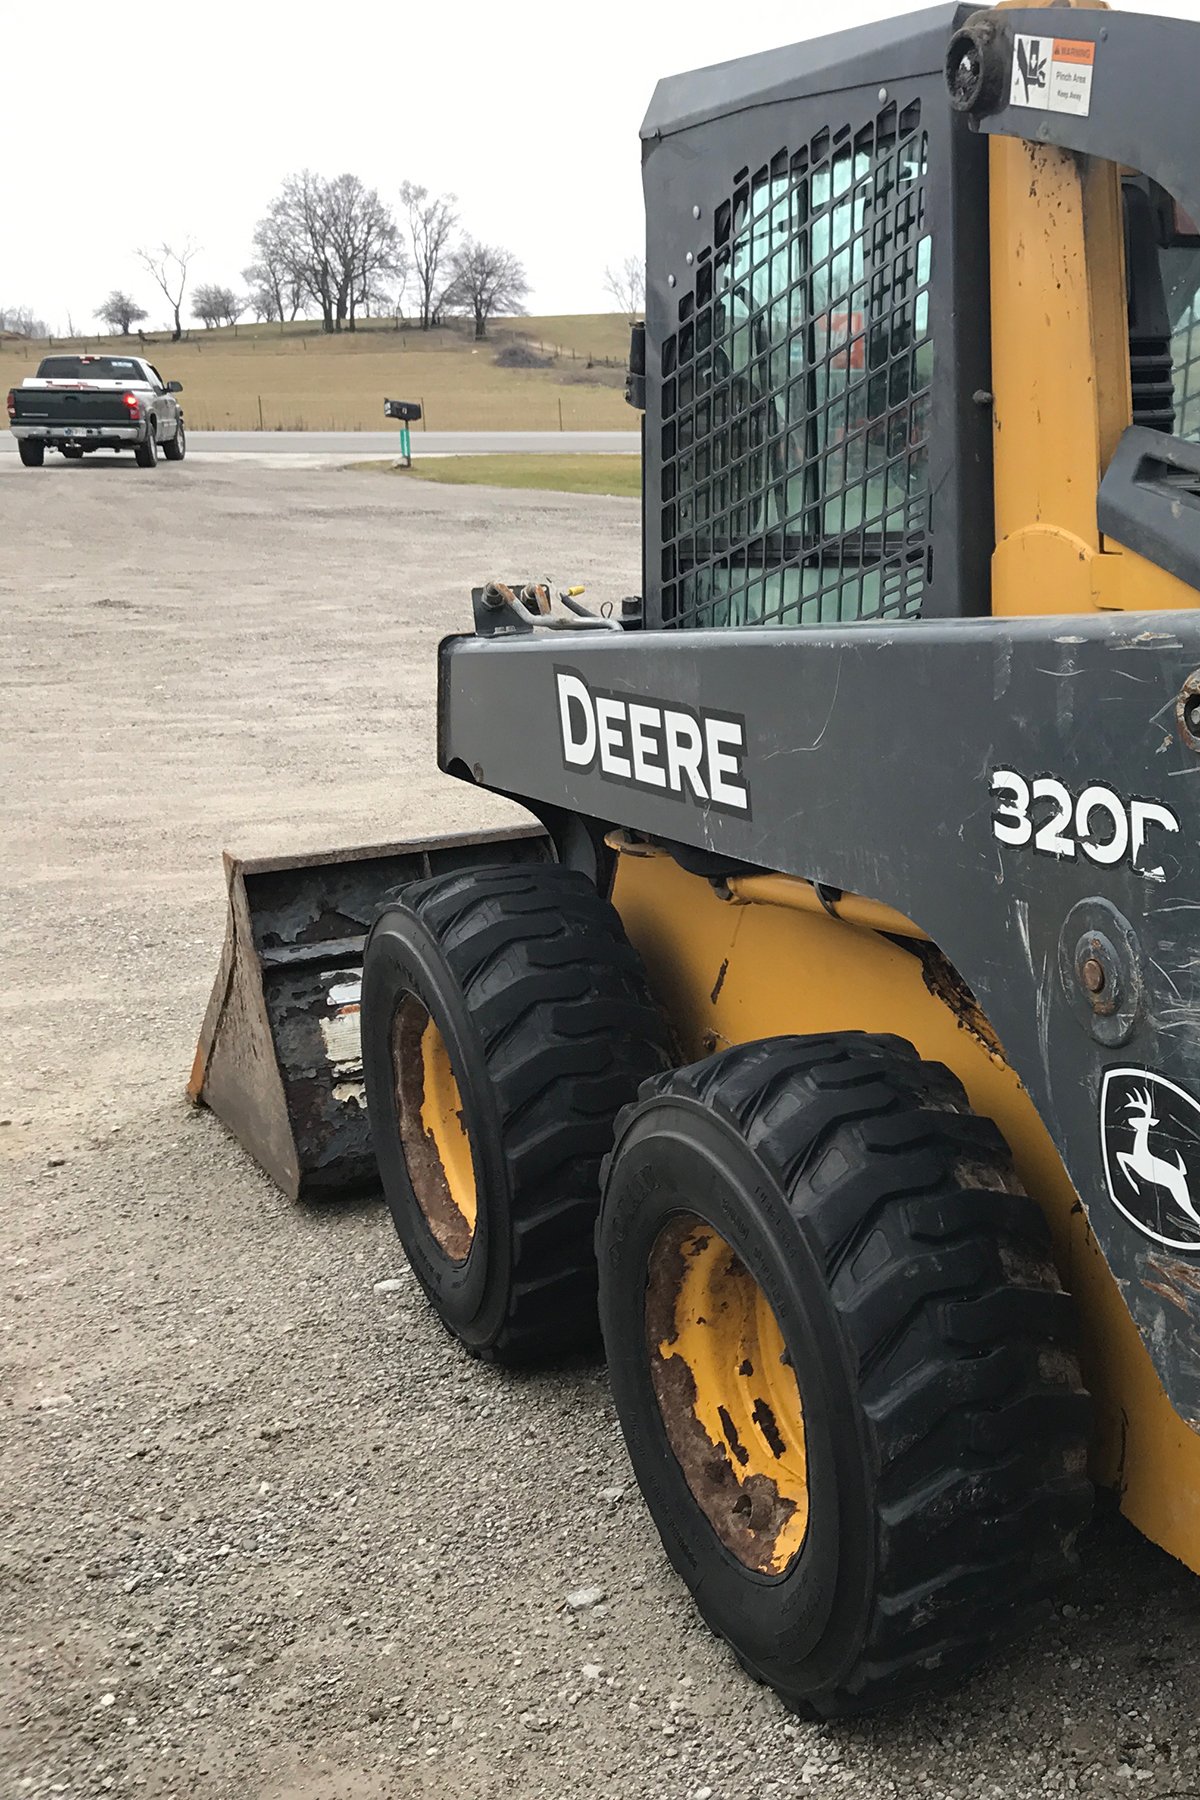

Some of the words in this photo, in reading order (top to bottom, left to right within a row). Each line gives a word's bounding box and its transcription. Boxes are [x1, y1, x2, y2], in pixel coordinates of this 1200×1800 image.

[1061, 47, 1091, 58] WARNING
[1056, 70, 1072, 81] Pinch
[1073, 73, 1086, 83] Area
[1057, 90, 1069, 100] Keep
[556, 673, 748, 809] DEERE
